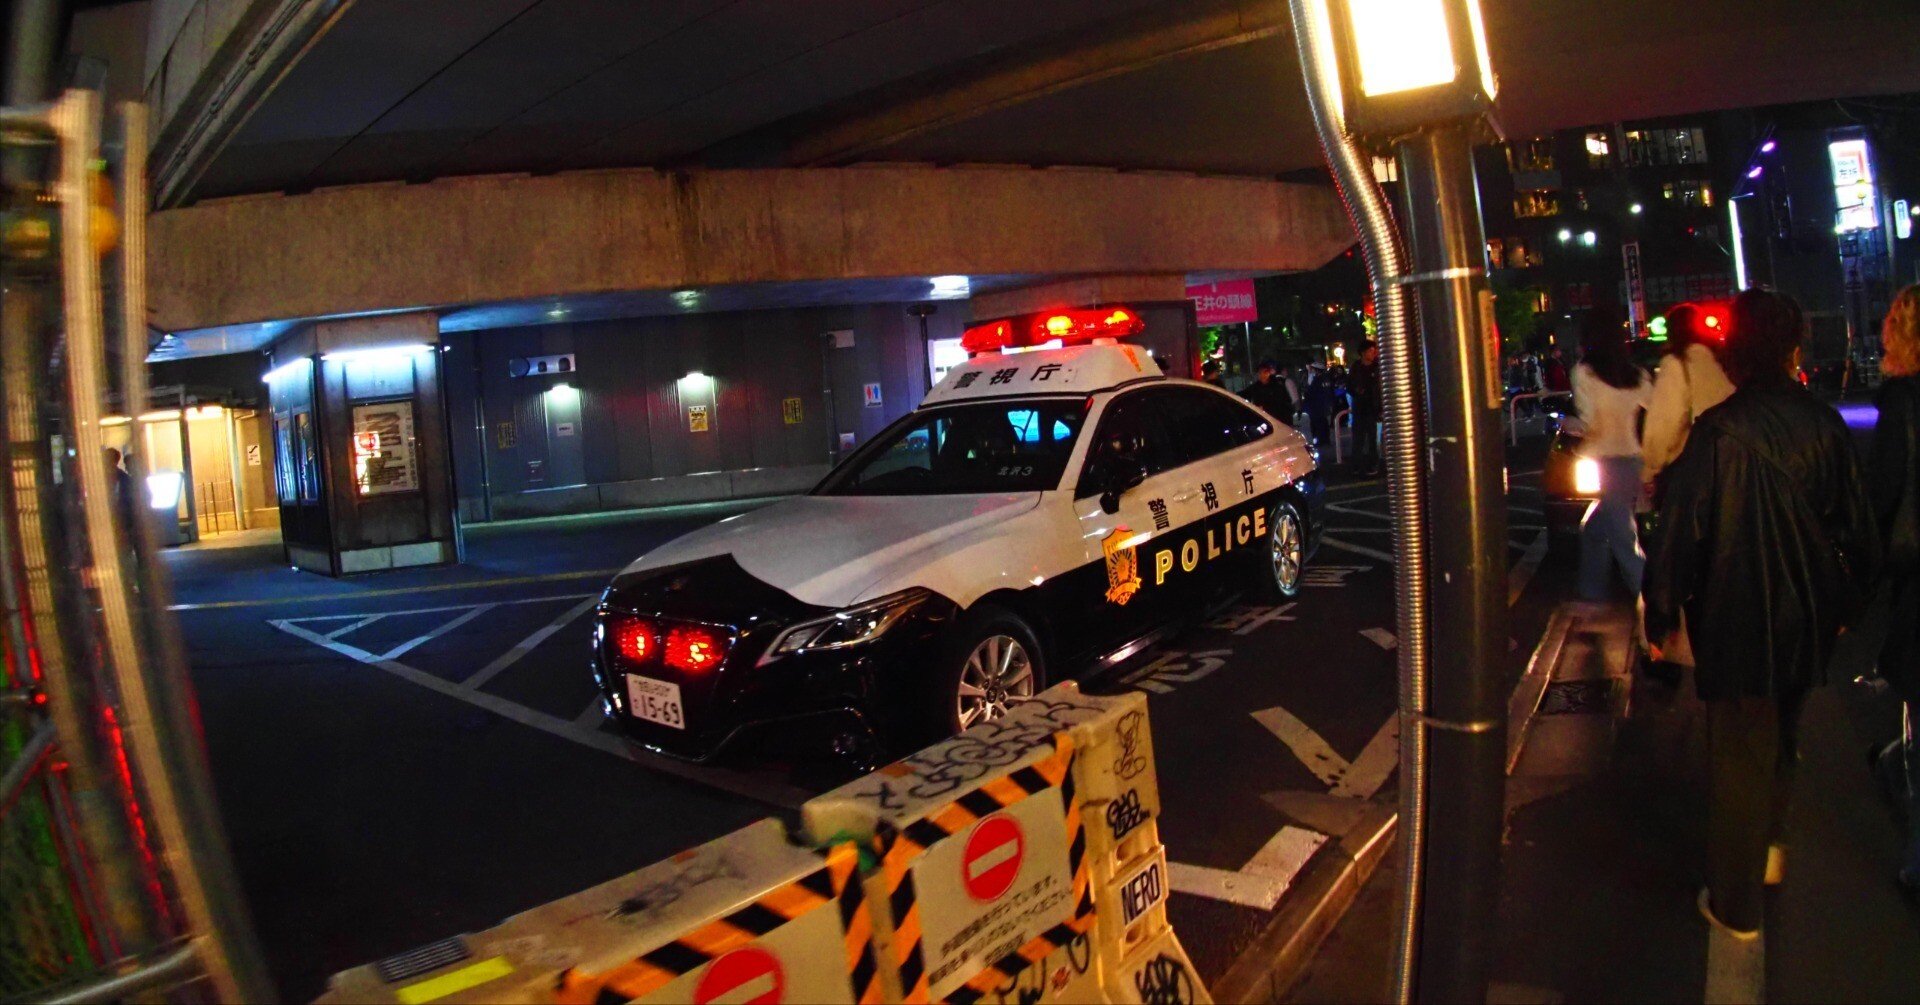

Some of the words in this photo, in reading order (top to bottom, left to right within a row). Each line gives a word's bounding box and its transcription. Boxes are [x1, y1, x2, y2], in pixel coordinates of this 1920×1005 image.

[953, 364, 1062, 390] 警視庁
[1147, 468, 1254, 531] 警視庁
[1155, 507, 1267, 586] POLICE
[1121, 863, 1161, 926] NERO
